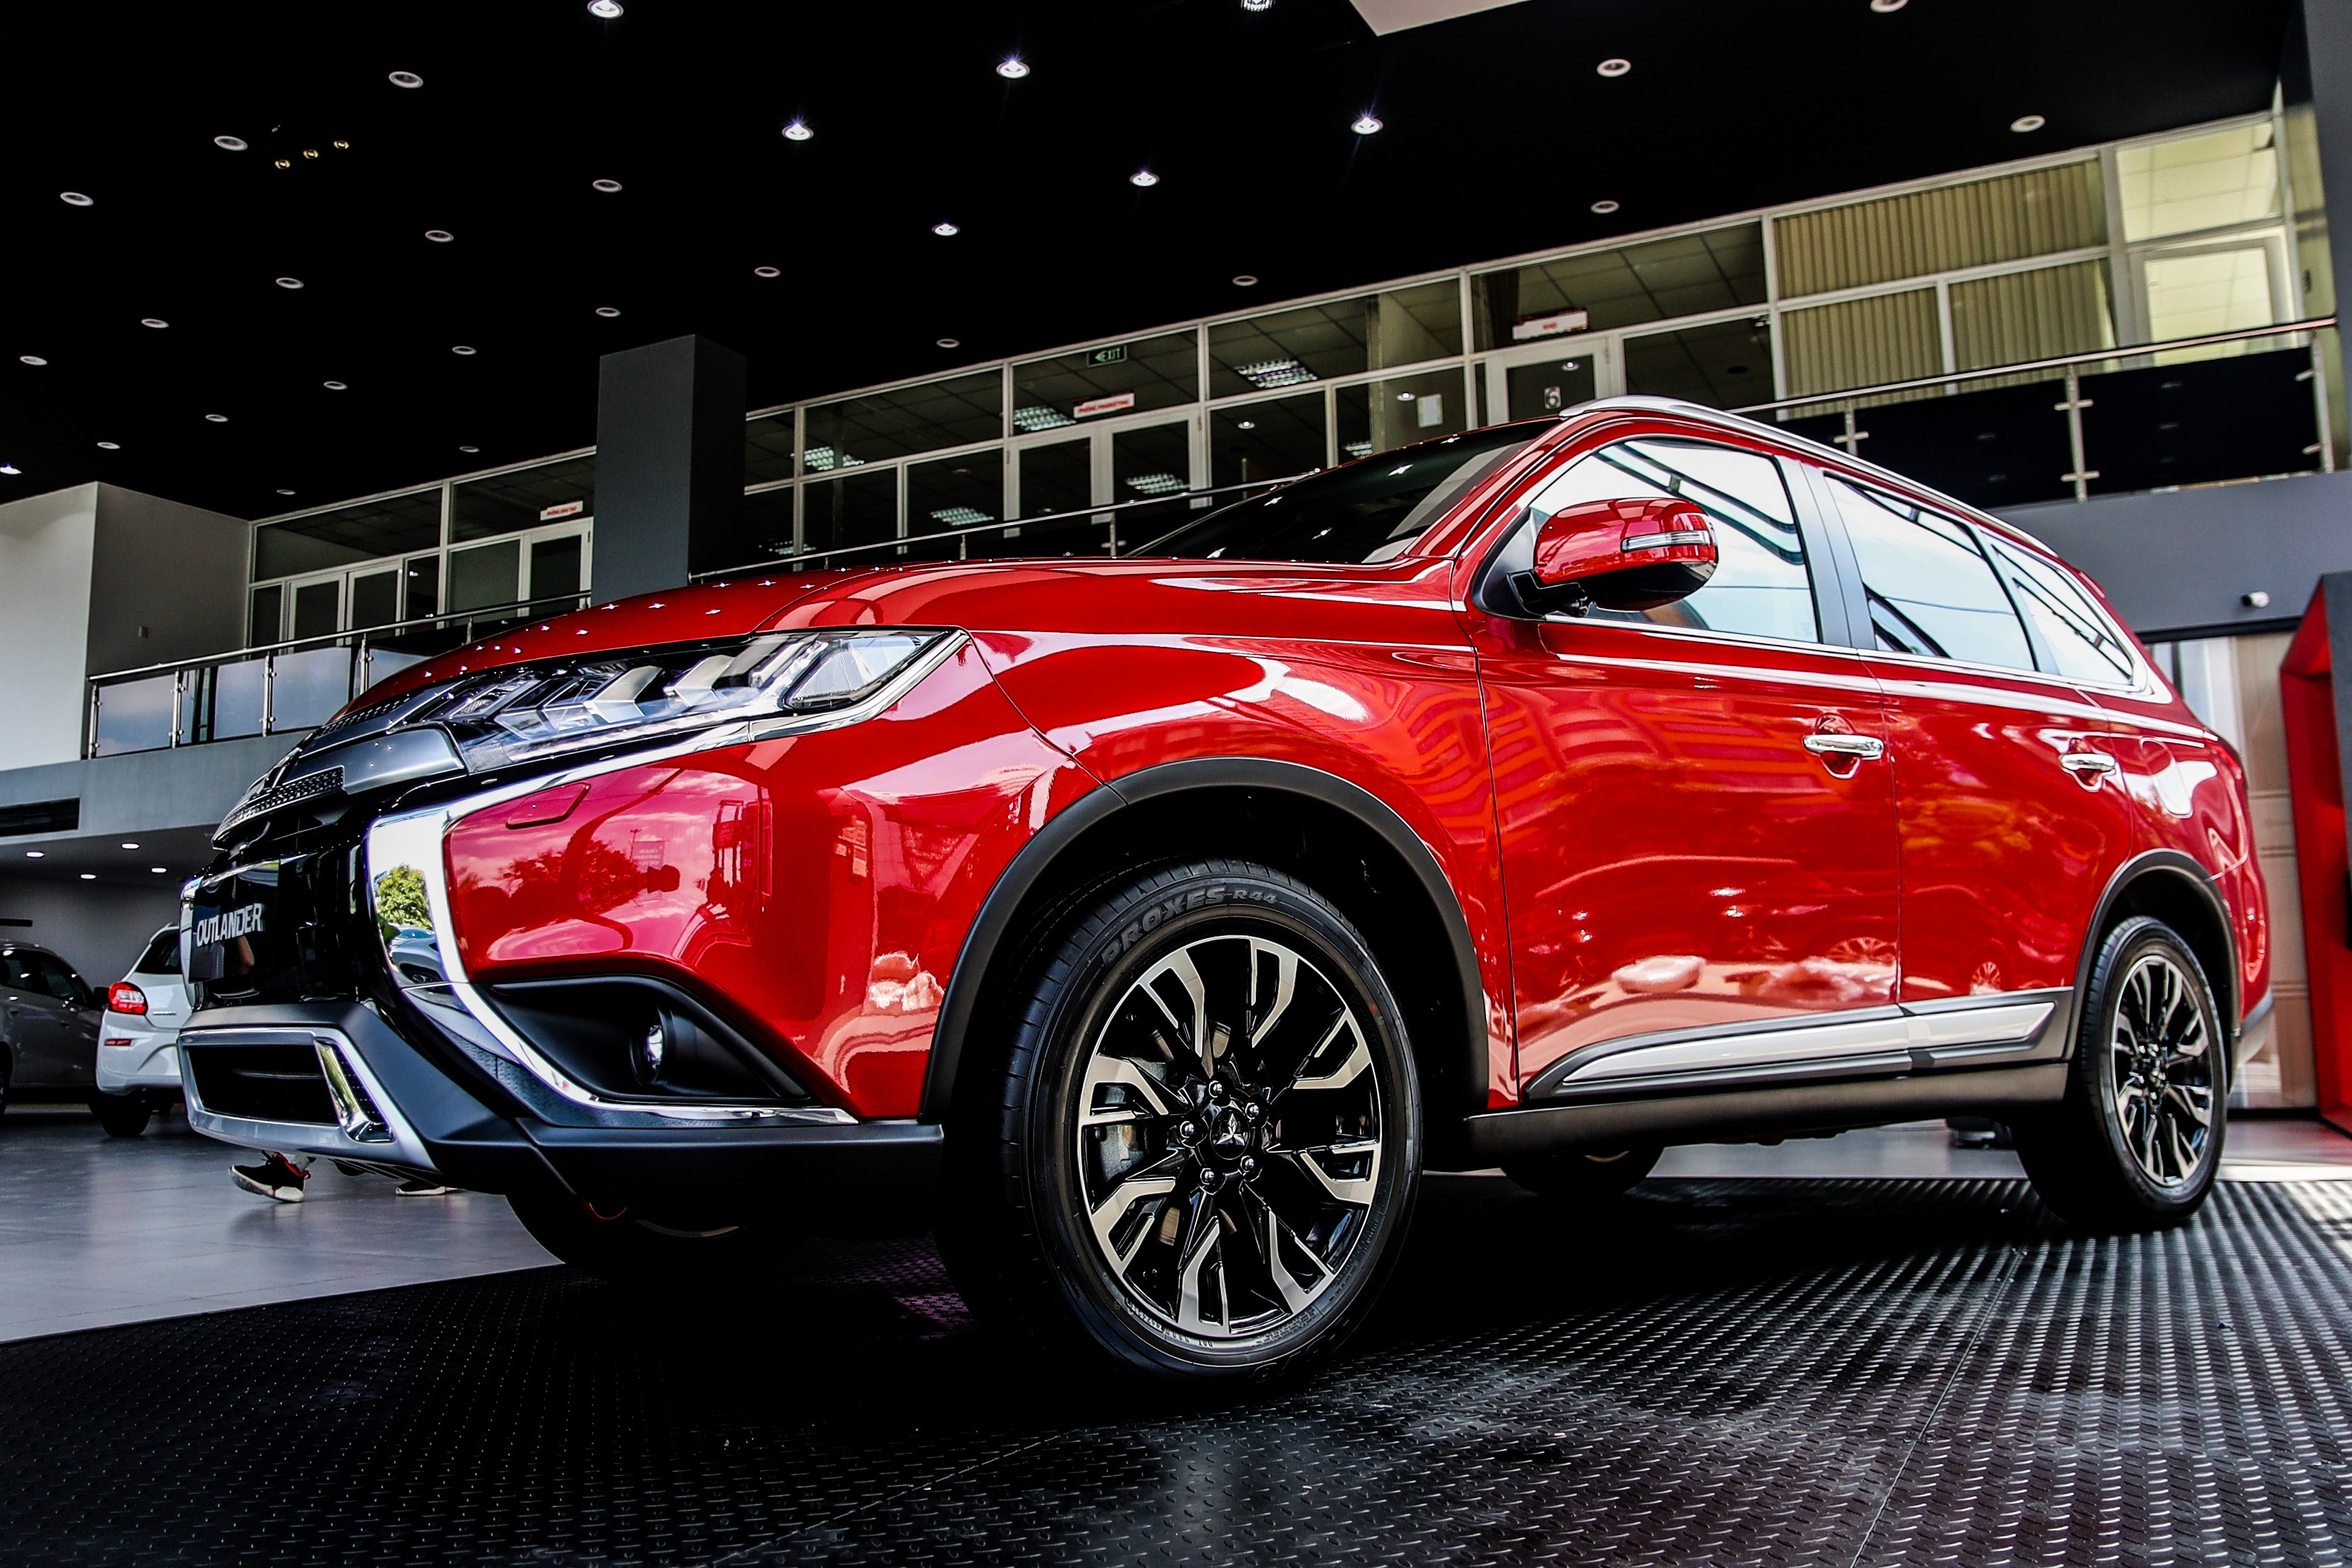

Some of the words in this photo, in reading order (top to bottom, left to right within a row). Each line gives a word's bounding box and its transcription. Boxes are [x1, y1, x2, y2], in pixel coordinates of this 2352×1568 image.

[197, 903, 263, 947] OUTLANDER
[1102, 886, 1227, 966] PROXES
[1232, 889, 1277, 905] R44
